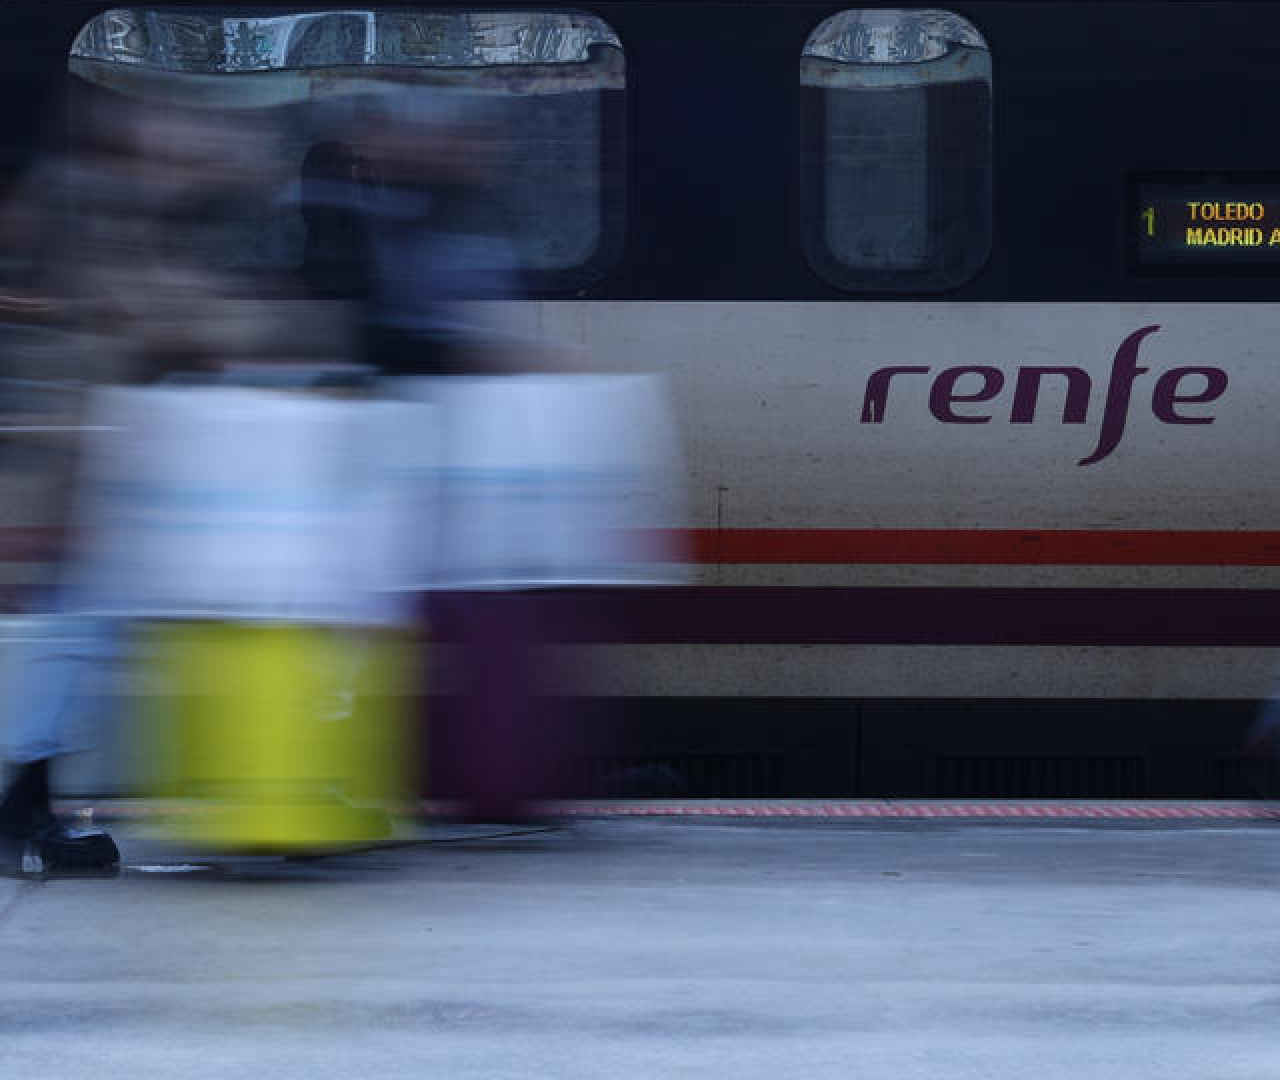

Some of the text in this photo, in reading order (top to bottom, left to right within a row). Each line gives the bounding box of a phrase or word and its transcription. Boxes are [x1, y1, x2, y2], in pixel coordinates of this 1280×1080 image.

[1142, 207, 1155, 236] 1
[1186, 201, 1264, 221] TOLEDO
[1186, 227, 1263, 247] MADRID
[860, 324, 1229, 466] renfe
